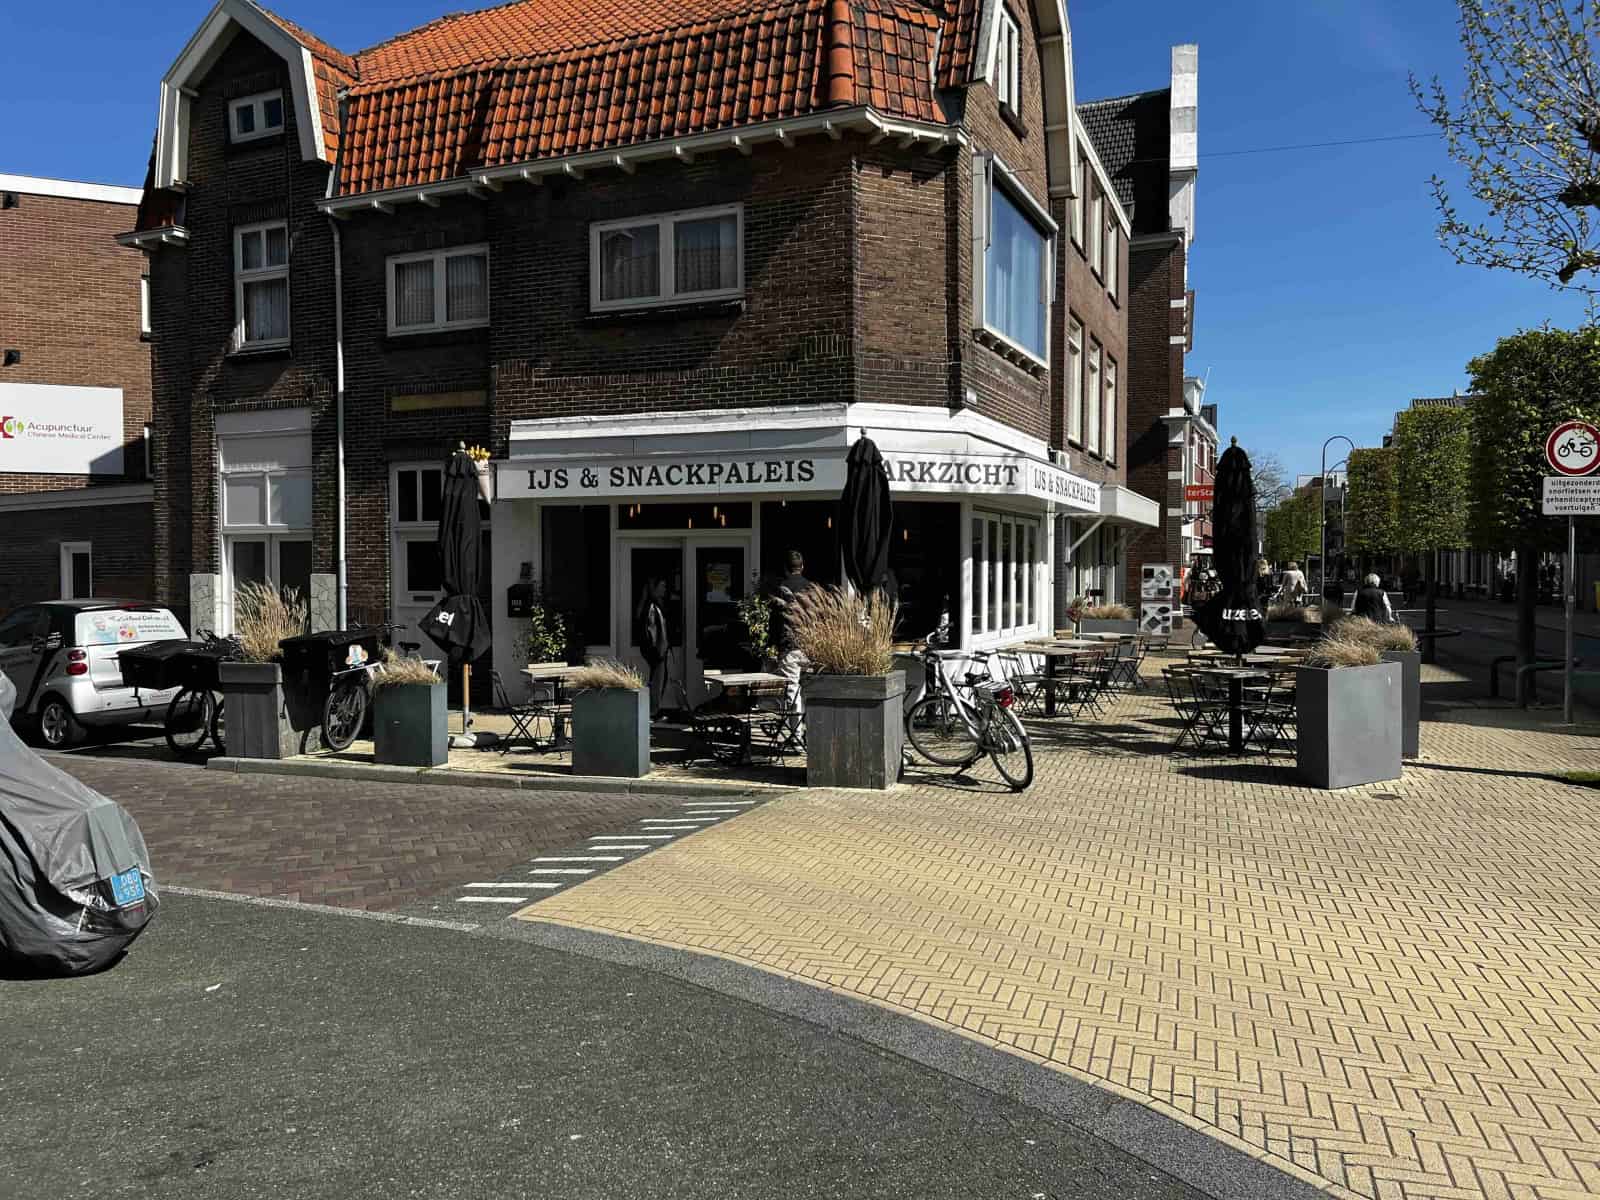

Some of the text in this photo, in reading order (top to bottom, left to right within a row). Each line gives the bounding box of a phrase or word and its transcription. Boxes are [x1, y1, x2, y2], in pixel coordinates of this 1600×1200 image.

[28, 422, 93, 432] Acupunctuur
[528, 460, 814, 489] IJS & SNACKPALEIS
[882, 460, 1019, 486] ARKZICHT
[1034, 468, 1096, 505] IJS & SNACKPALEIS
[1188, 488, 1213, 496] terSta
